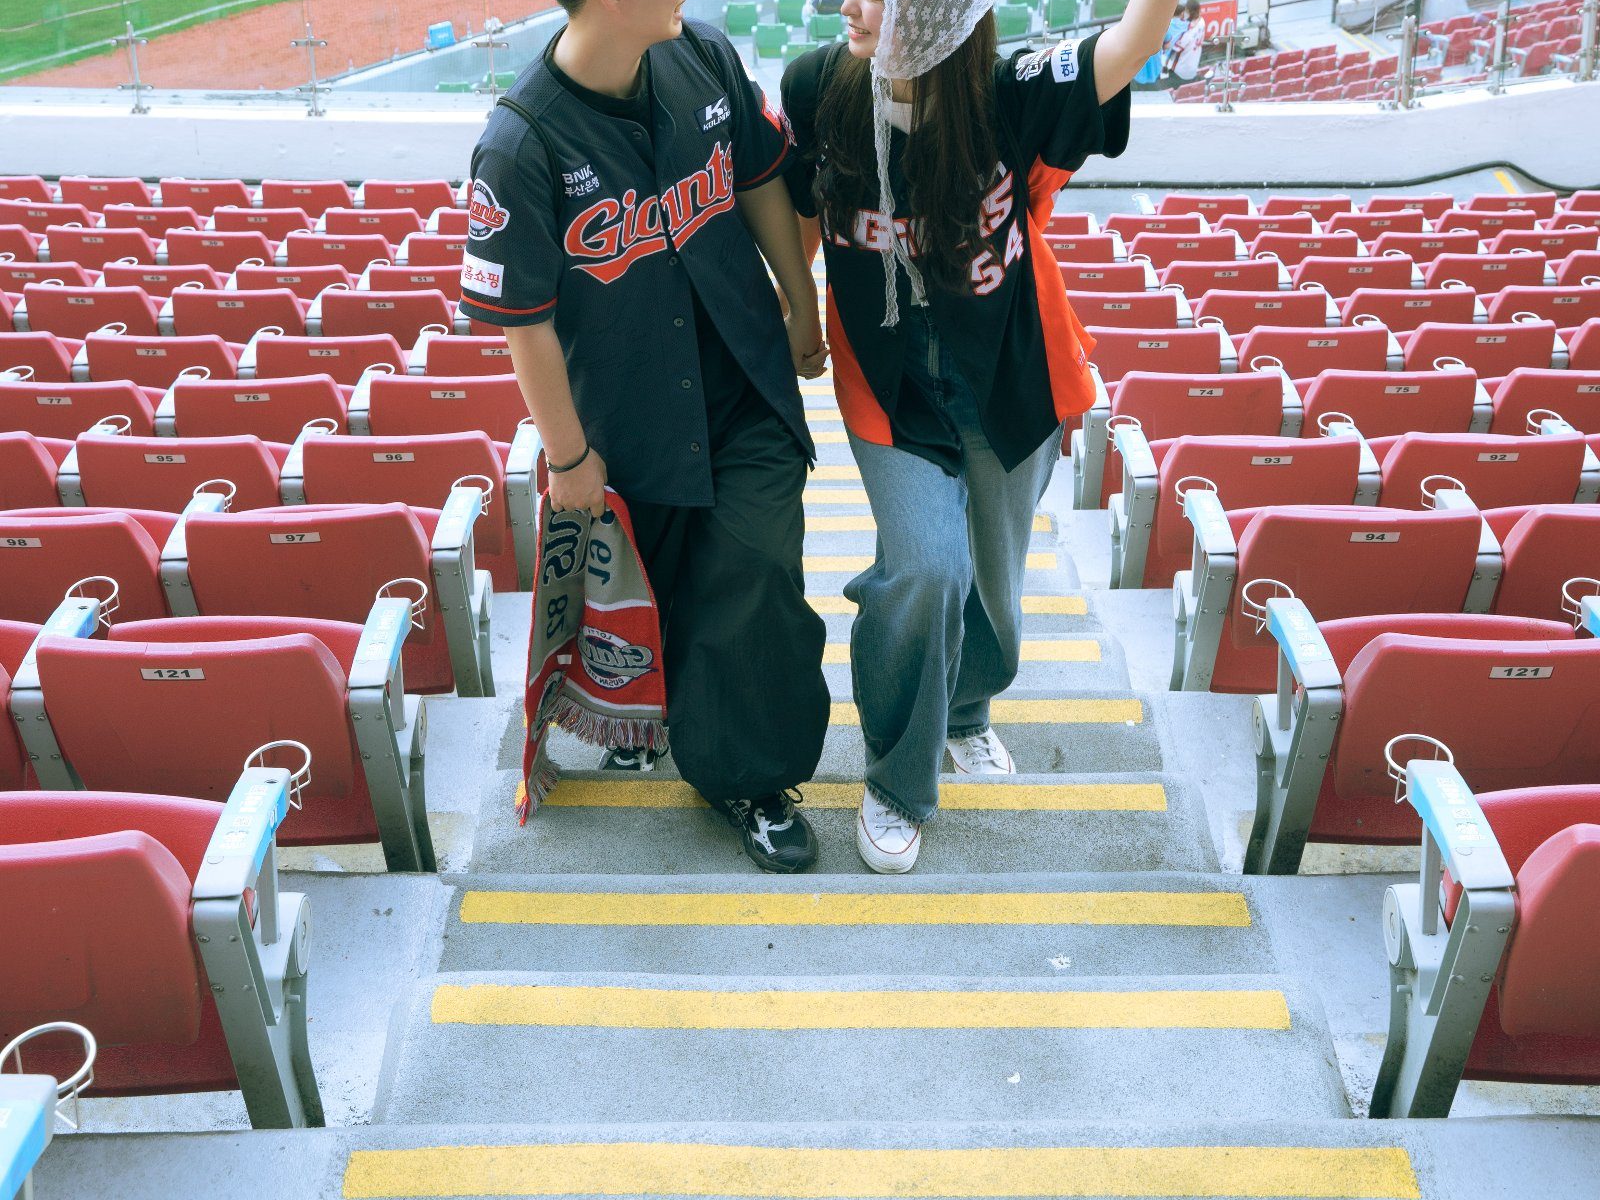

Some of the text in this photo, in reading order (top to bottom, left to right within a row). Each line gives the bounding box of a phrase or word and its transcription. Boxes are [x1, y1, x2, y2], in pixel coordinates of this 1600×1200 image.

[561, 163, 594, 185] BNK
[564, 174, 600, 197] 부산은행
[470, 200, 507, 227] ants
[463, 264, 500, 289] 홈쇼핑
[1199, 388, 1214, 396] 74
[47, 397, 65, 405] 77
[244, 393, 261, 401] 76
[385, 453, 403, 461] 96
[285, 533, 306, 542] 97
[1365, 533, 1386, 541] 94
[6, 538, 28, 547] 98
[153, 668, 194, 678] 121
[1503, 667, 1540, 677] 121
